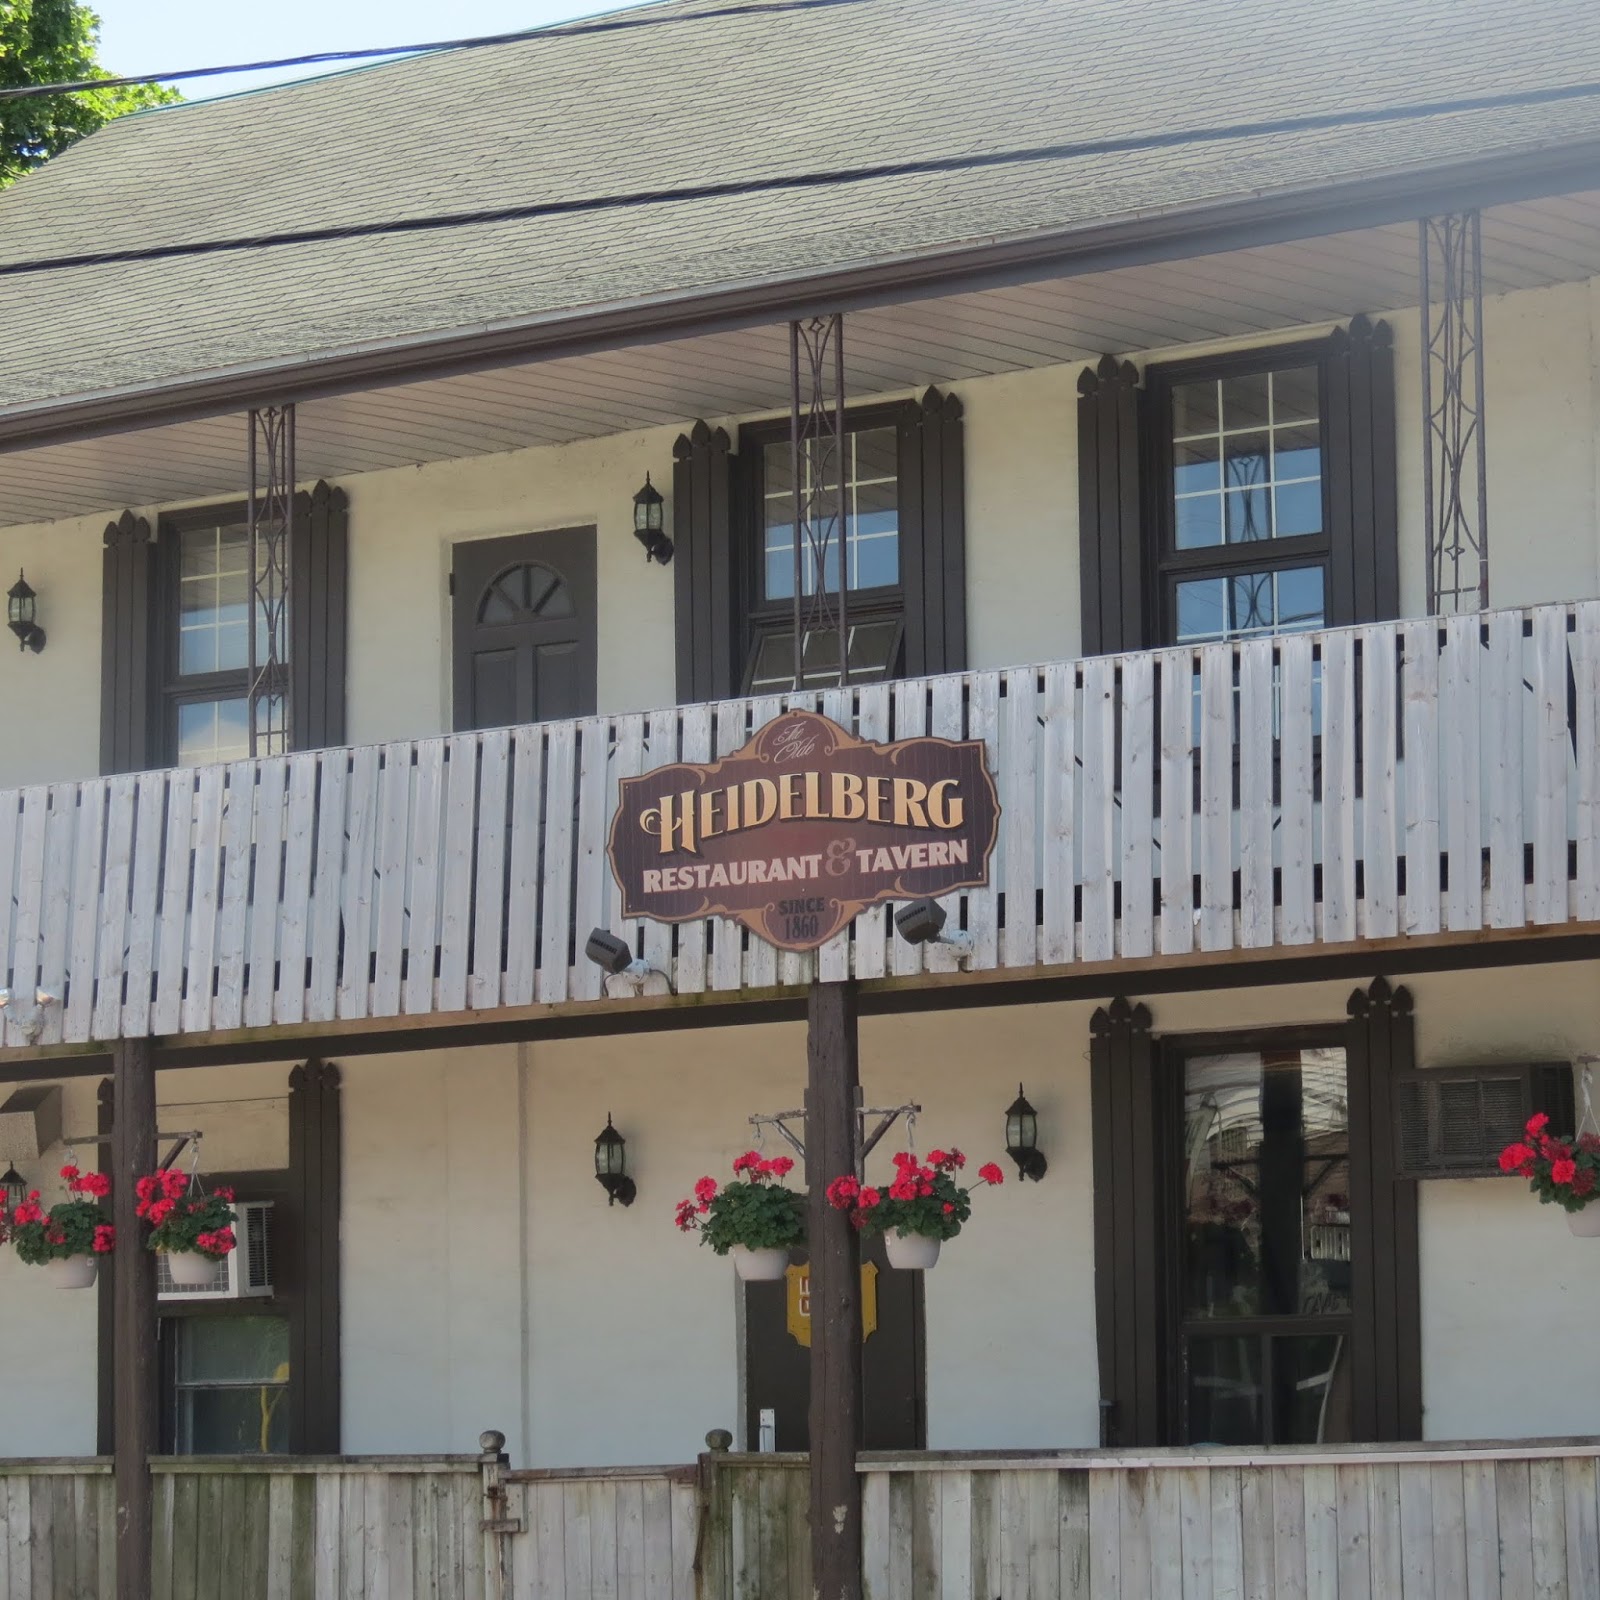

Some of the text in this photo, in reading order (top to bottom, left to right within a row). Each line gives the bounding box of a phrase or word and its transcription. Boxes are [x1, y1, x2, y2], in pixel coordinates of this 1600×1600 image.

[774, 734, 819, 764] Olde
[639, 771, 964, 854] HEIDELBERG
[643, 837, 969, 893] RESTAURANT & TAVERN
[778, 897, 825, 916] SINCE
[784, 914, 819, 940] 1860
